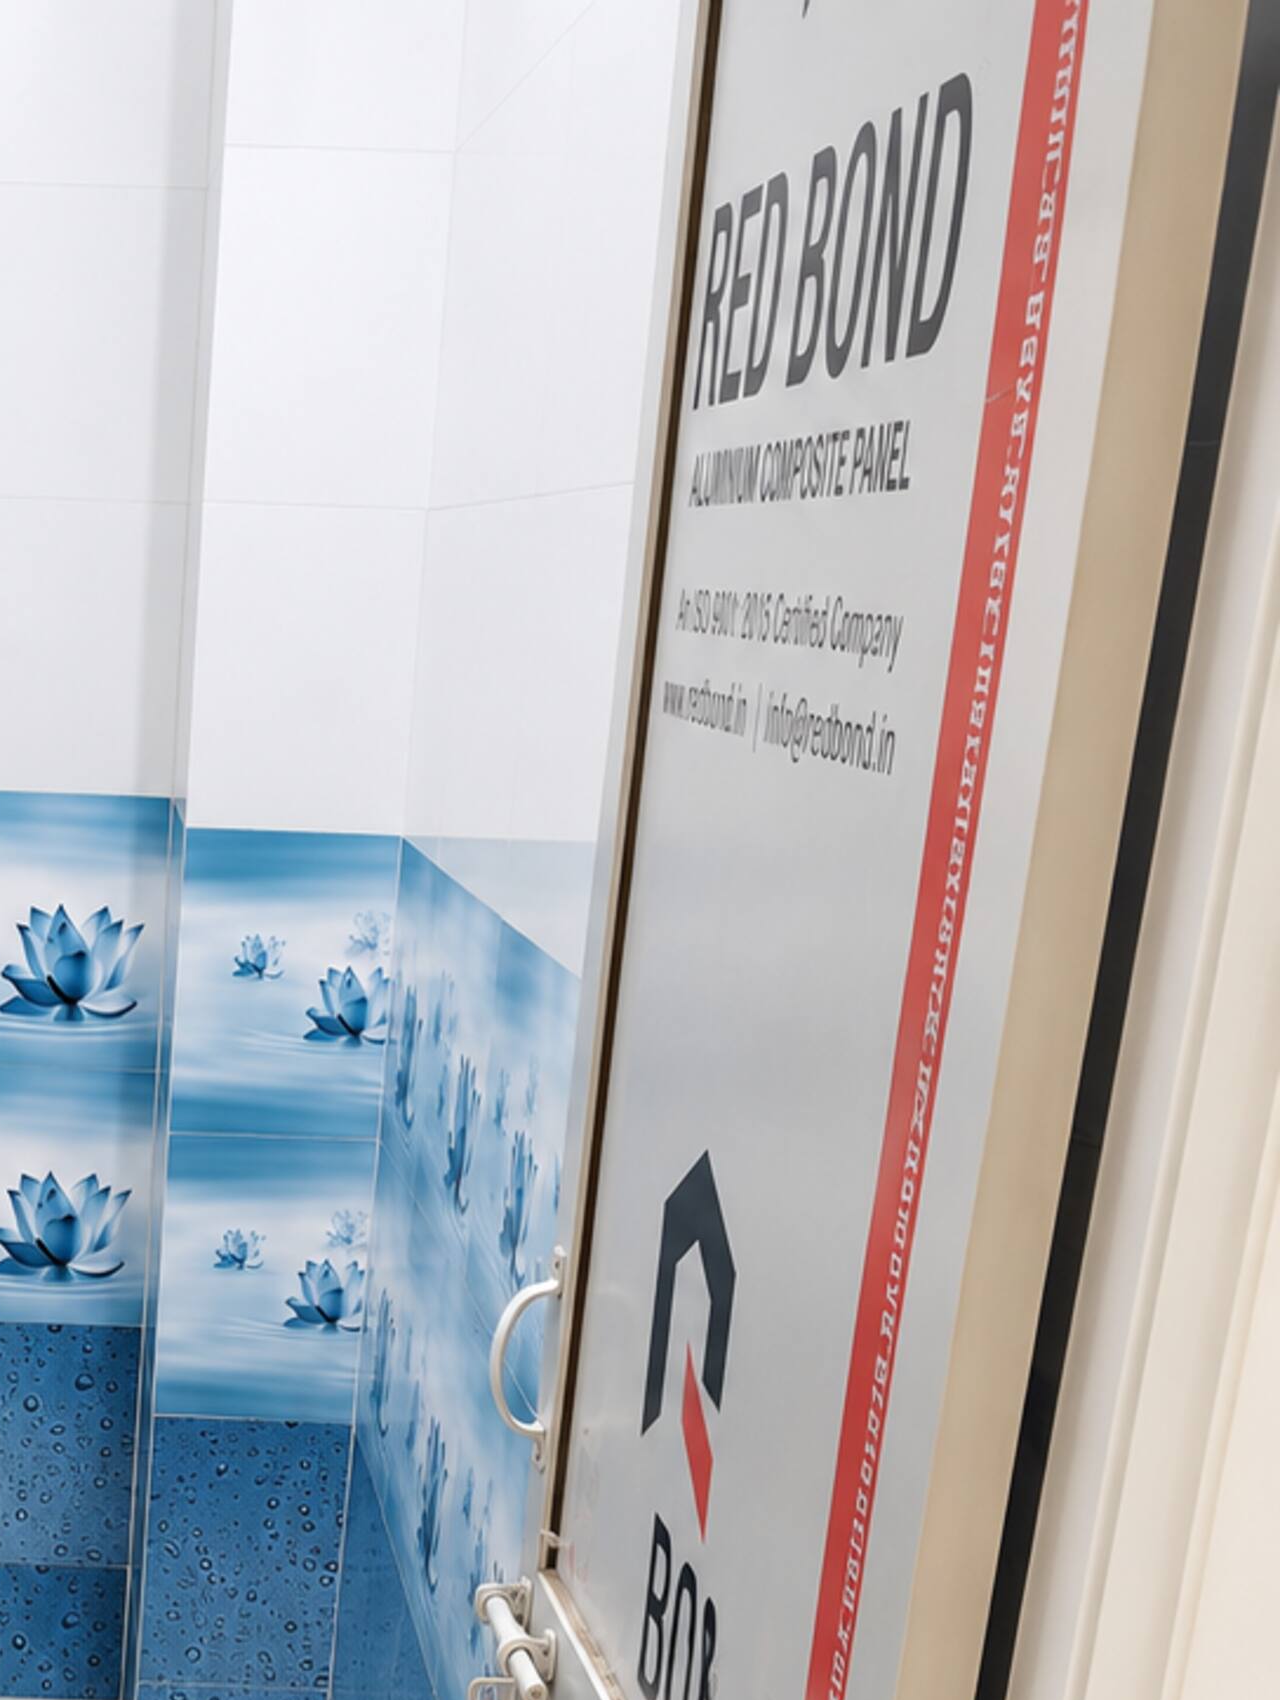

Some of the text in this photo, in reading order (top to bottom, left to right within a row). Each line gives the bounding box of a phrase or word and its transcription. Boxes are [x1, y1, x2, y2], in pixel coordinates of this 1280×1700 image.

[693, 171, 789, 410] RED
[786, 72, 973, 387] BOND
[760, 429, 851, 503] COMPOSITE
[849, 420, 911, 495] PANEL
[830, 595, 904, 674] Company
[763, 690, 896, 776] info@redbond.in
